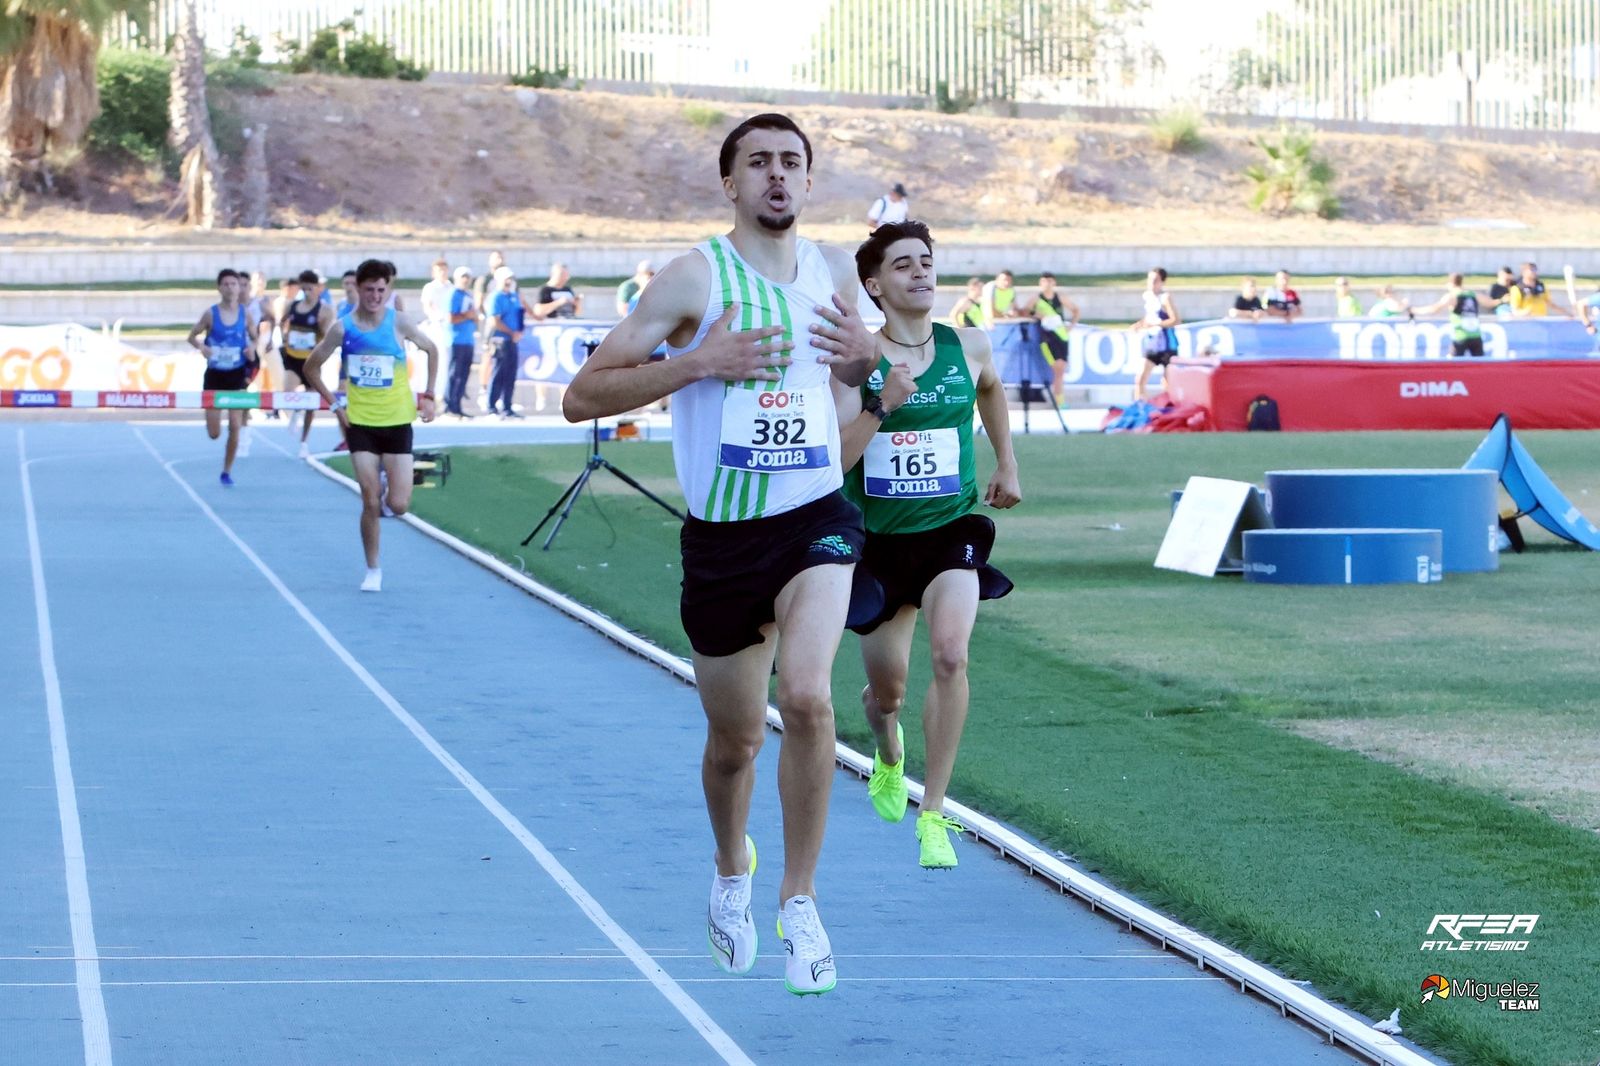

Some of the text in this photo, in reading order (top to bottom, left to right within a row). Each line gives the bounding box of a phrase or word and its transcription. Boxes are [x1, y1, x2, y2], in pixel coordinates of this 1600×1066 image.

[0, 347, 70, 391] GO
[360, 365, 382, 377] 578
[1401, 381, 1469, 397] DIMA
[752, 418, 806, 446] 382
[890, 453, 937, 476] 165
